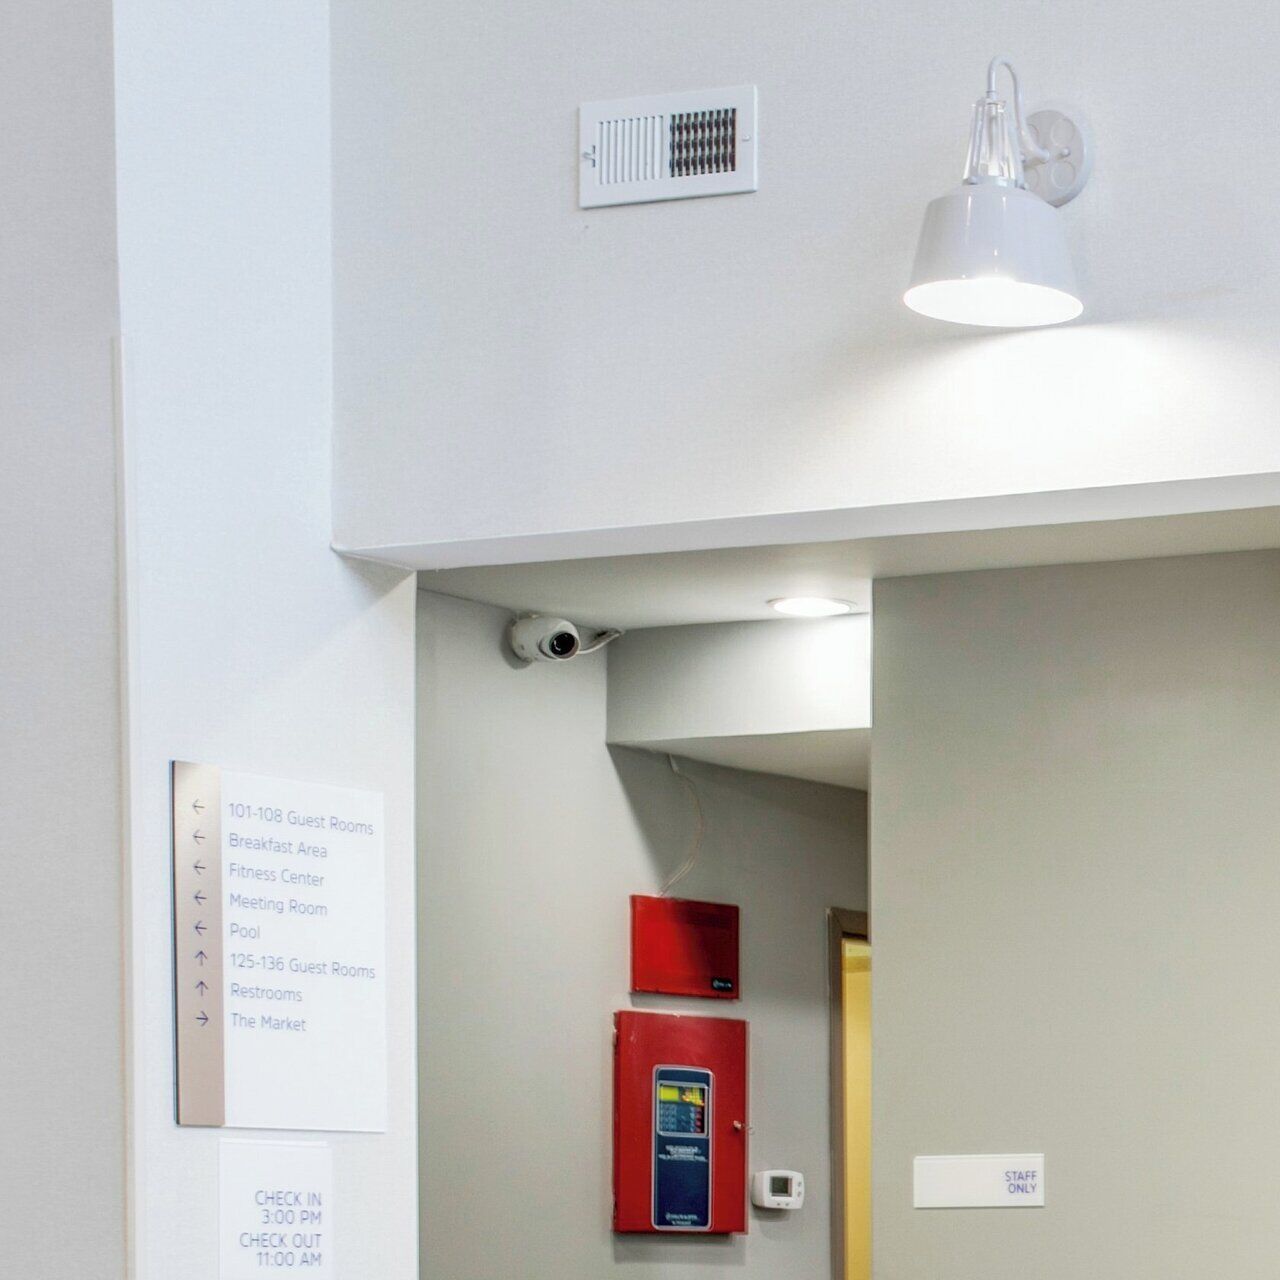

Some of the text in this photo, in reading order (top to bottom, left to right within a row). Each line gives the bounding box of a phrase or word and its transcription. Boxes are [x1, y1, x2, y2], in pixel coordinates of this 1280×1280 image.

[229, 803, 374, 836] 101-108 Guest Rooms
[229, 832, 328, 858] Breakfast Area
[229, 862, 325, 887] Fitness Center
[229, 892, 328, 916] Meeting Room
[230, 922, 261, 939] Pool
[230, 953, 376, 979] 125-136 Guest Rooms
[230, 982, 303, 1002] Restrooms
[231, 1012, 306, 1032] The Market
[1004, 1170, 1037, 1182] STAFF
[1007, 1183, 1037, 1194] ONLY
[255, 1190, 322, 1206] CHECK IN
[261, 1208, 322, 1224] 3:00 PM
[239, 1232, 322, 1248] CHECK OUT
[256, 1251, 322, 1267] 11:00 AM
